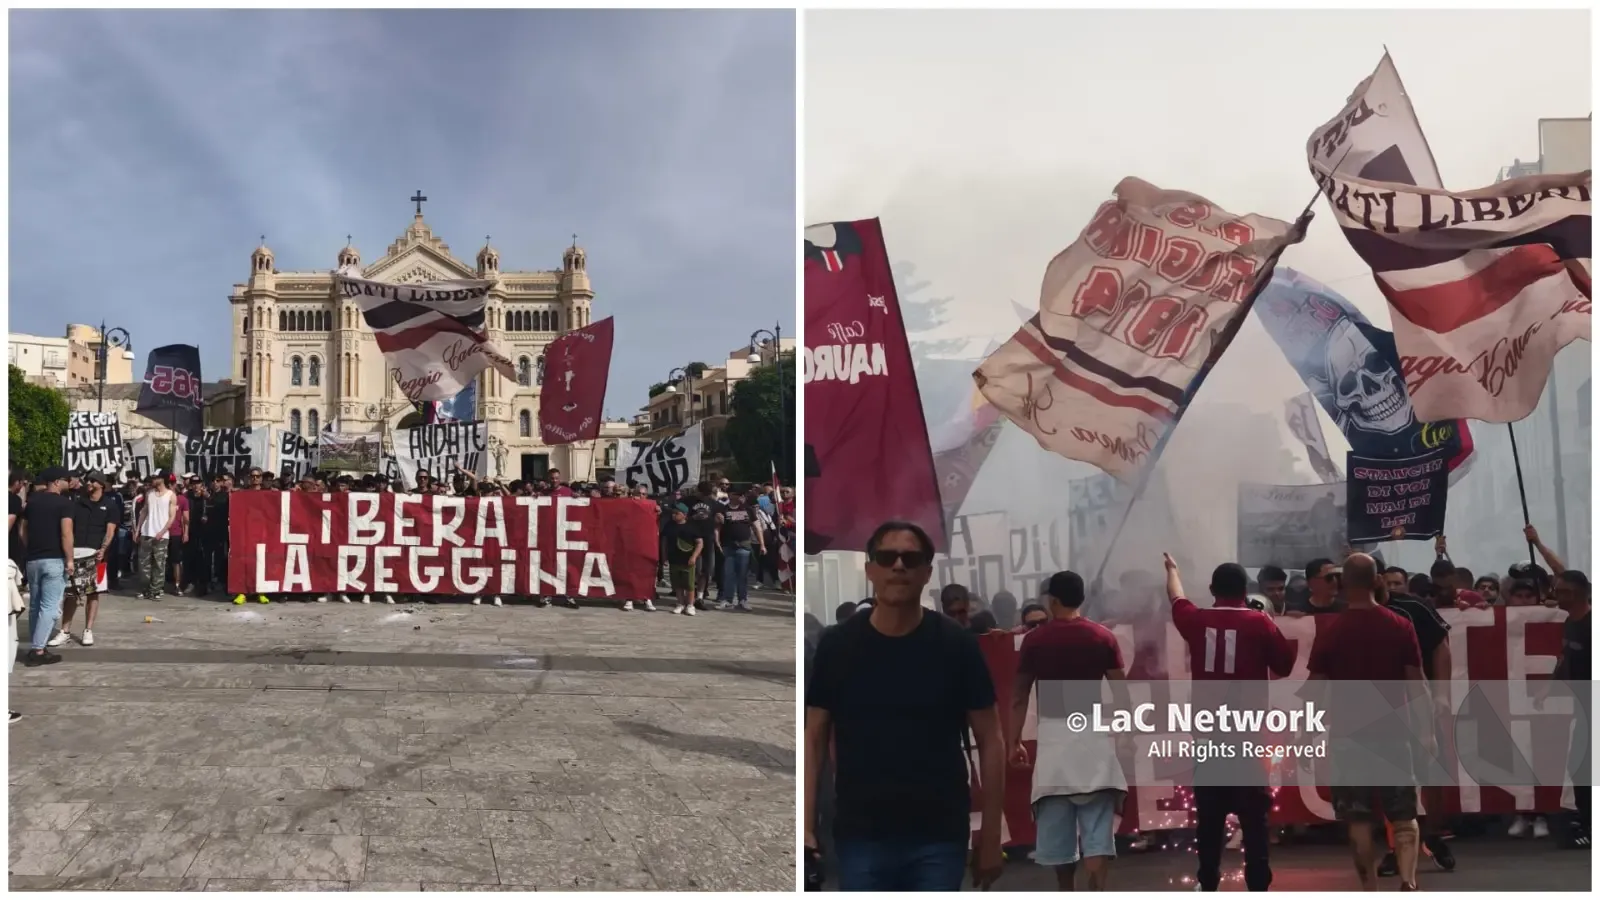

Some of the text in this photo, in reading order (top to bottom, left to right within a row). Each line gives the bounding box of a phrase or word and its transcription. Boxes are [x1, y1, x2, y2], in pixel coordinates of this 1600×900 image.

[409, 420, 486, 460] ANDATE
[631, 431, 687, 466] THE
[67, 447, 122, 472] VUOLE
[1354, 458, 1443, 480] STANCHI
[626, 457, 690, 496] END
[1367, 478, 1431, 497] DI VOI
[1366, 493, 1431, 514] MAI DI
[1381, 512, 1416, 529] LEI
[256, 543, 312, 593] LA
[1204, 627, 1238, 674] 11
